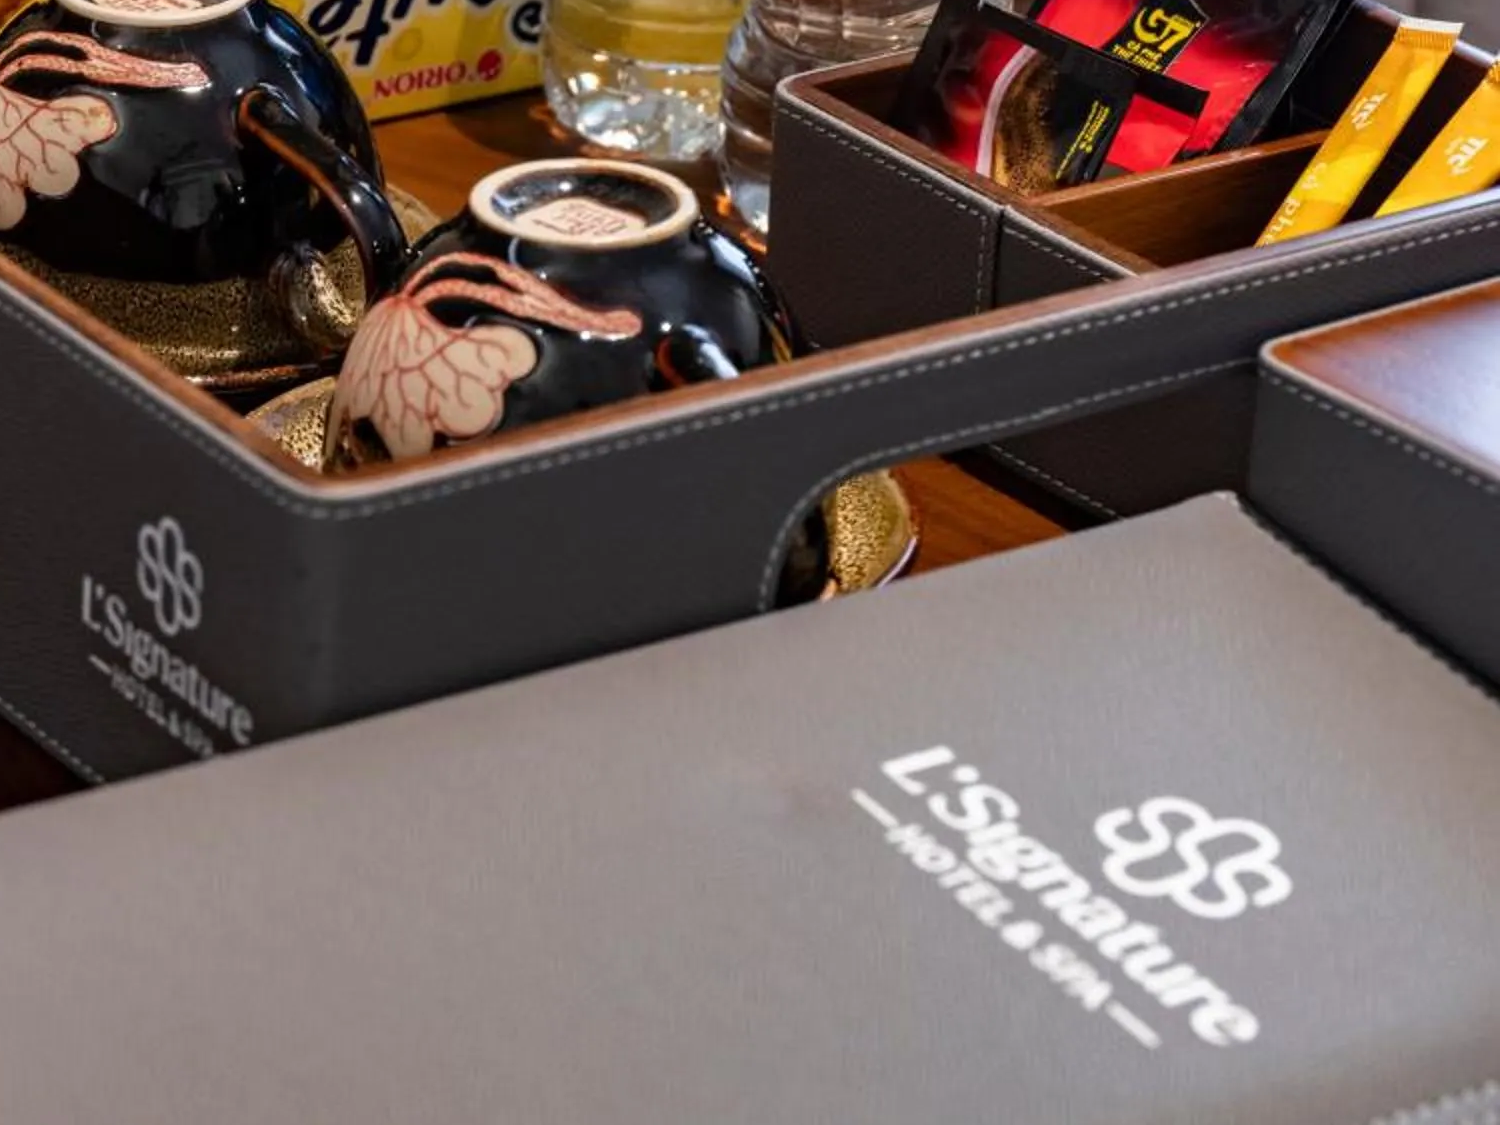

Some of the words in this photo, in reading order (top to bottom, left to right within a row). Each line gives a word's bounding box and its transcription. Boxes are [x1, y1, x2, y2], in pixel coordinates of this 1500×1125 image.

[373, 61, 467, 99] ORION
[1133, 6, 1196, 54] G7
[81, 573, 255, 747] L'Signature
[880, 744, 1261, 1047] L'Signature
[885, 822, 1015, 929] HOTEL
[1001, 919, 1044, 952] &
[1028, 942, 1114, 1012] SPA
